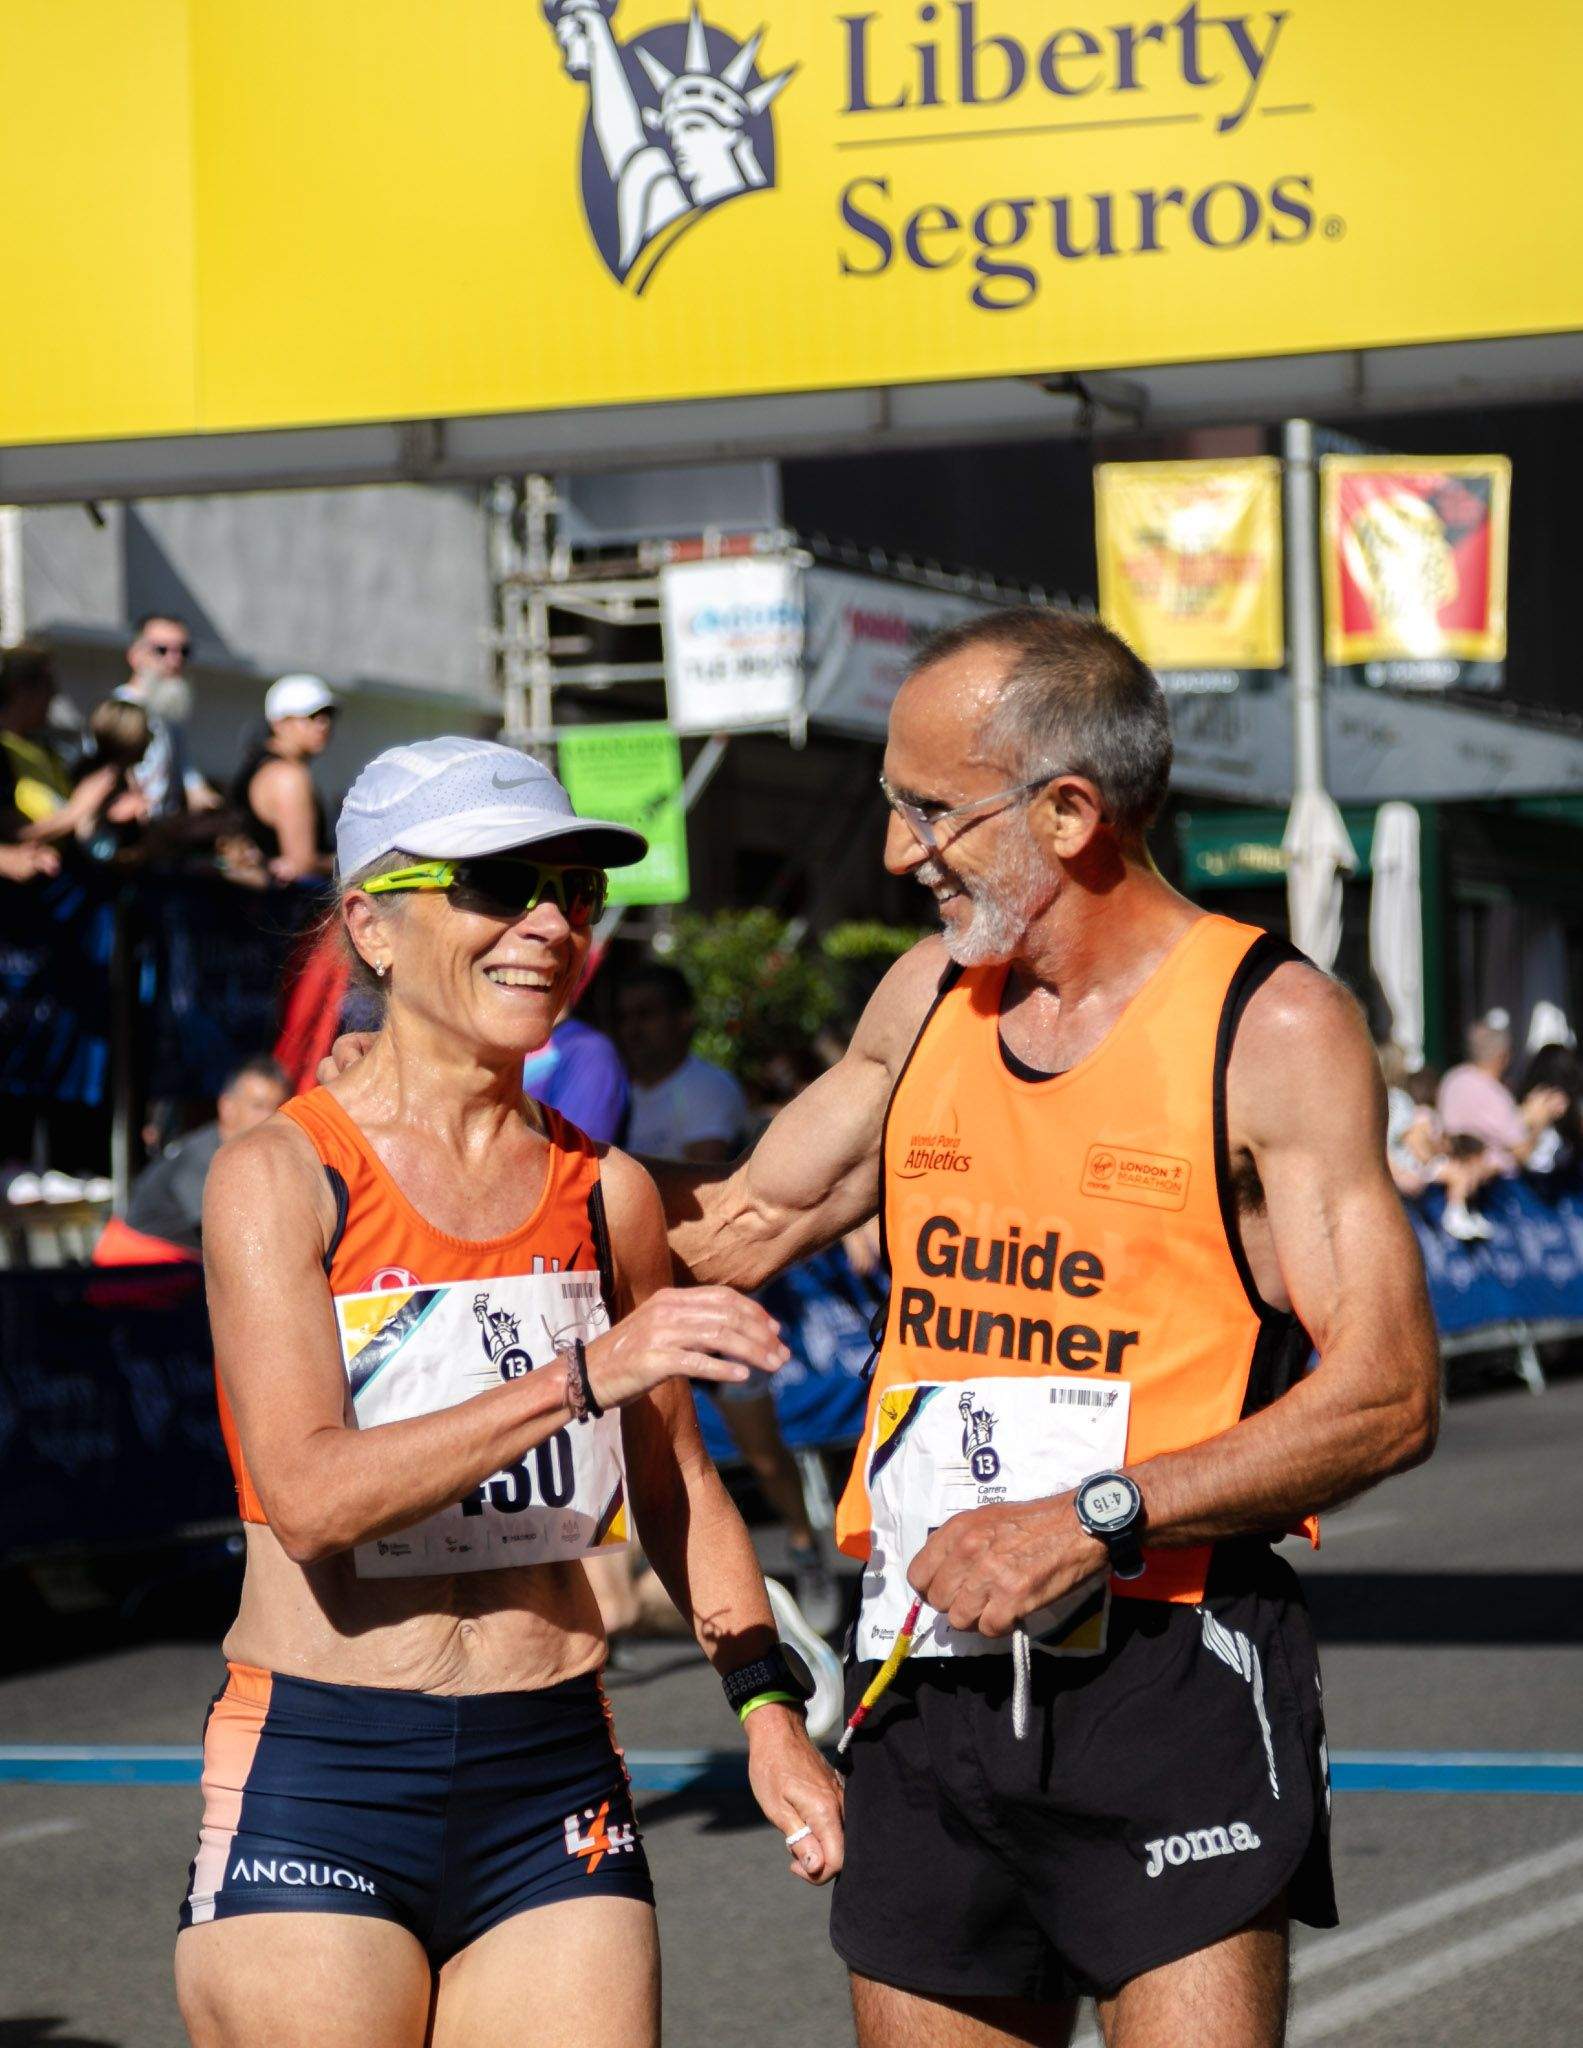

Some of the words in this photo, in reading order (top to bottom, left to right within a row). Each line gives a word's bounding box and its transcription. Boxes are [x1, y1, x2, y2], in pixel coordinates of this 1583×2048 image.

[838, 0, 1292, 133] Liberty
[839, 174, 1316, 311] Seguros
[904, 1149, 972, 1173] Athletics
[1120, 1160, 1168, 1178] LONDON
[1118, 1172, 1182, 1191] MARATHON
[916, 1215, 1105, 1298] Guide
[899, 1286, 1140, 1374] Runner
[505, 1355, 528, 1378] 13
[977, 1455, 994, 1475] 13
[977, 1485, 1007, 1495] Carrera
[1093, 1491, 1122, 1514] 4:15
